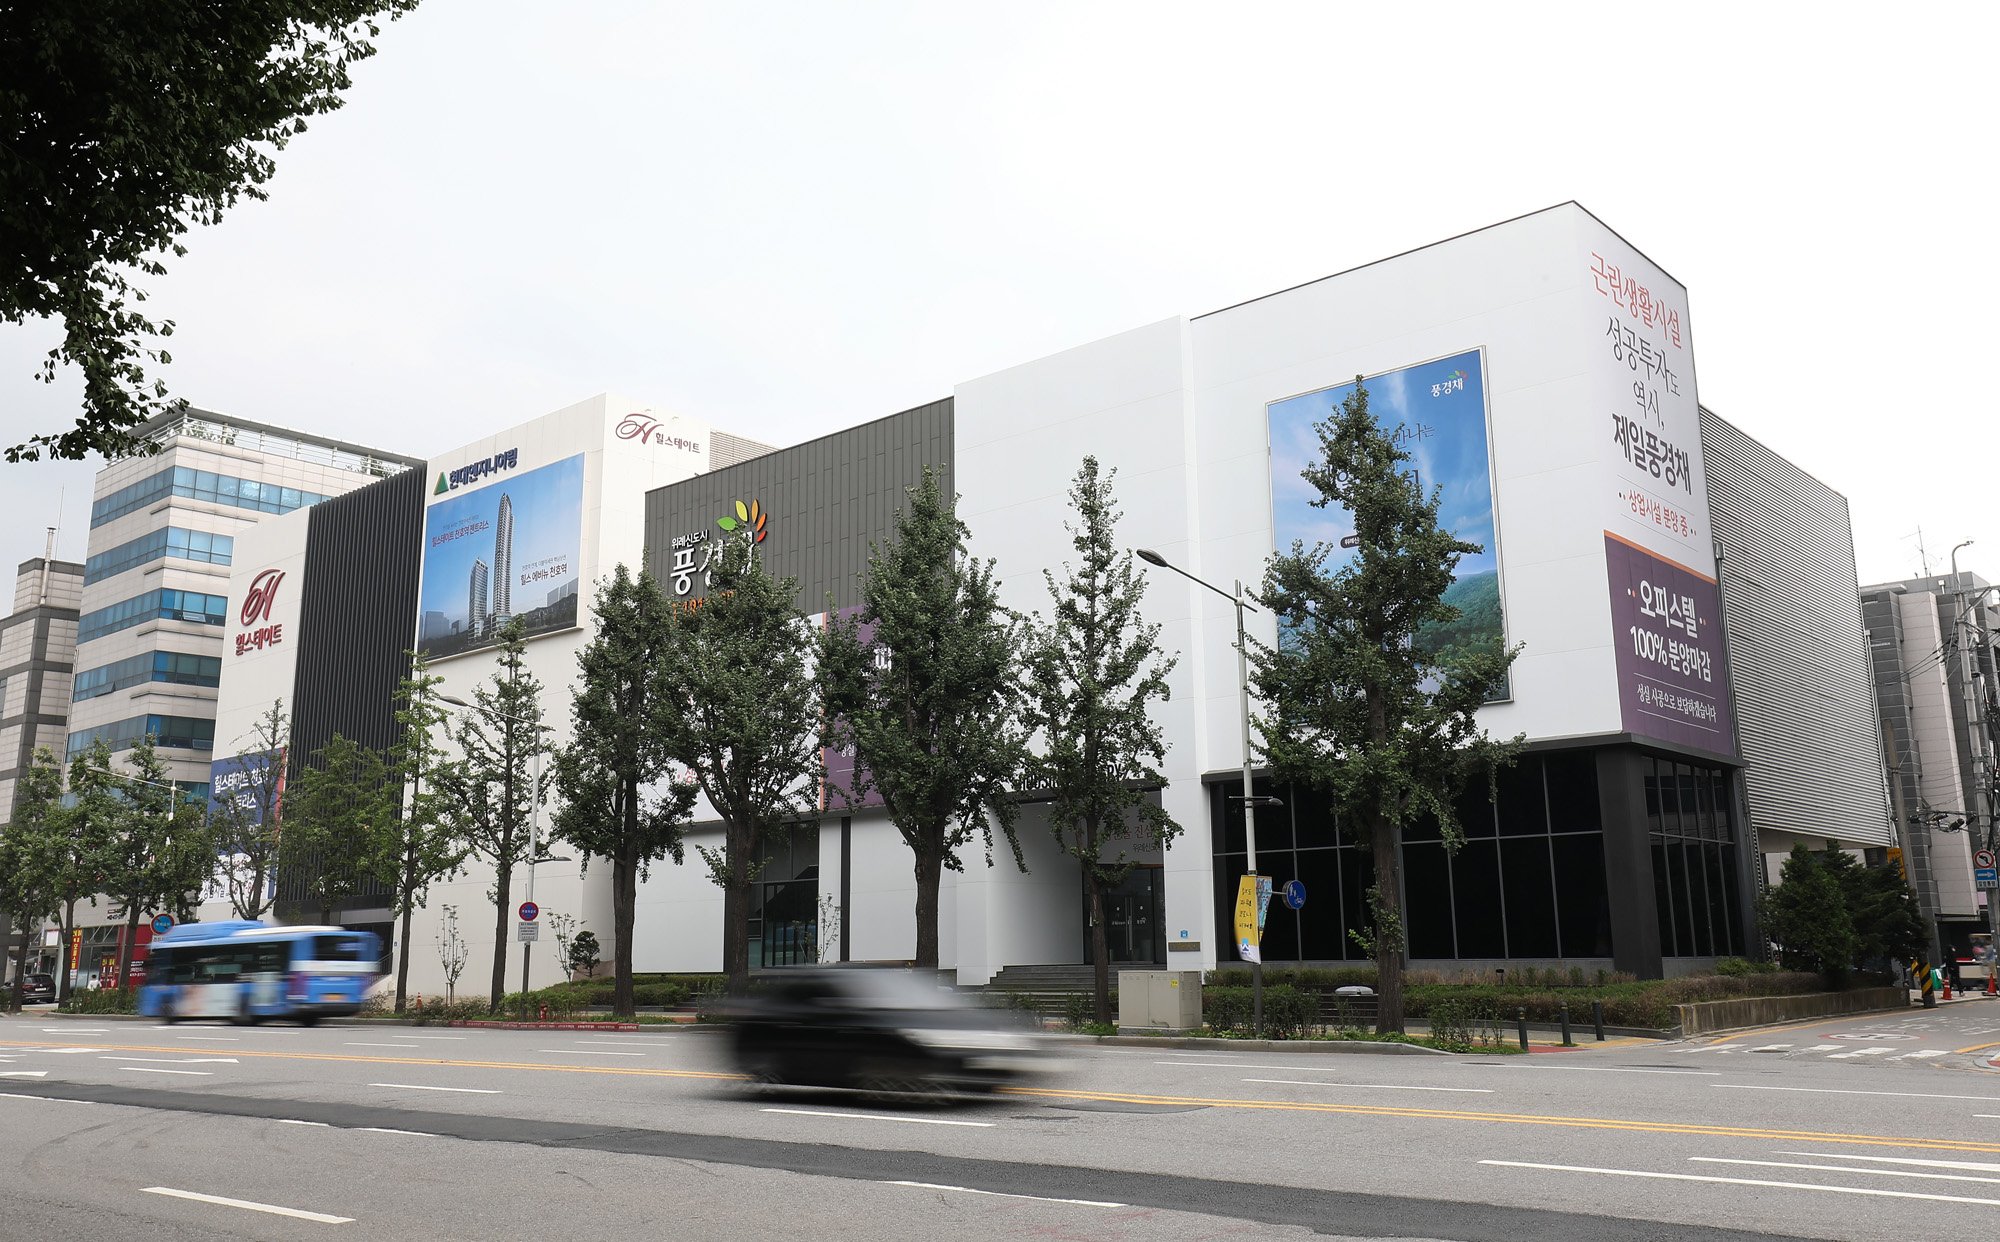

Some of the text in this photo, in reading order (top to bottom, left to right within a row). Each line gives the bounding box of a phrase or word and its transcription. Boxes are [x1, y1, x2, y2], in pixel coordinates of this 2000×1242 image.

[1590, 251, 1682, 350] 근린생활시설
[1606, 316, 1681, 397] 성공투자도
[1431, 378, 1463, 398] 풍경채
[1633, 380, 1665, 431] 역시,
[655, 432, 701, 454] 힐스테이트
[1612, 413, 1692, 496] 제일풍경채
[449, 447, 519, 490] 현대엔지니어링
[1629, 489, 1688, 537] 상업시설 분양 중
[432, 530, 455, 548] 힐스테이트
[671, 529, 709, 550] 위례신도시
[549, 562, 568, 578] 천호역
[670, 532, 755, 596] 풍경
[1640, 579, 1699, 639] 오피스텔
[235, 623, 283, 656] 힐스테이트
[1629, 625, 1712, 683] 100% 분양마감
[1636, 683, 1717, 724] 성실 시공으로 보답하겠습니다
[214, 770, 250, 794] 힐스테이트
